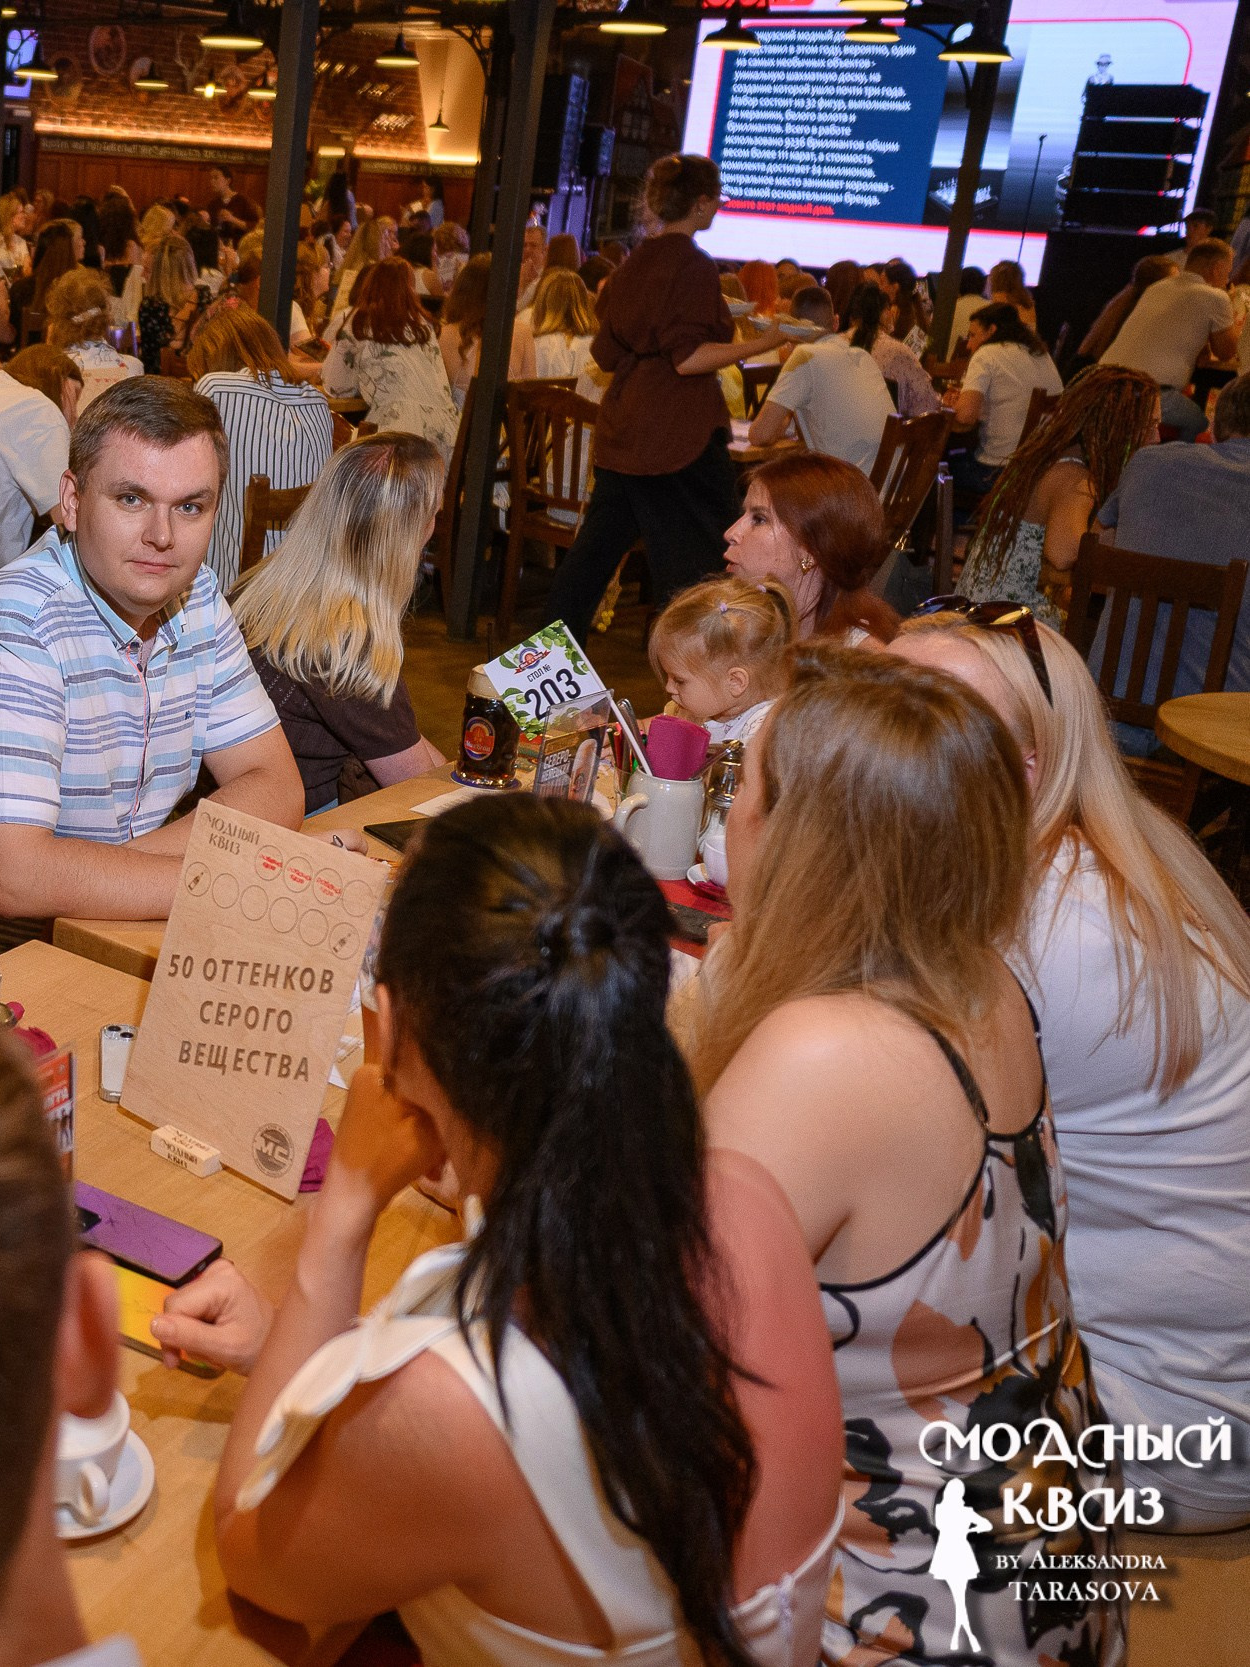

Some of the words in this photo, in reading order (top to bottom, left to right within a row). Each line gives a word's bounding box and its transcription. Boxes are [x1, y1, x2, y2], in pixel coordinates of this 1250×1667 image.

[797, 29, 833, 41] модный
[796, 45, 819, 54] этом
[891, 46, 916, 57] один
[748, 58, 775, 68] самых
[786, 71, 837, 84] шахматную
[869, 73, 881, 83] на
[732, 83, 772, 94] создание
[773, 83, 810, 96] которой
[811, 84, 835, 97] ушло
[836, 85, 863, 95] почти
[730, 95, 758, 109] Набор
[759, 97, 794, 108] состоит
[785, 109, 816, 121] белого
[817, 111, 848, 122] золота
[785, 122, 810, 134] Всего
[818, 124, 851, 137] работе
[784, 136, 806, 149] 9236
[865, 139, 900, 153] общим
[722, 148, 749, 158] весом
[750, 147, 777, 159] более
[825, 152, 873, 165] стоимость
[744, 186, 770, 199] самой
[775, 176, 802, 187] место
[802, 177, 845, 189] занимает
[845, 180, 888, 193] королева
[527, 667, 544, 683] СТОЛ
[524, 668, 581, 721] 203
[201, 811, 260, 846] МОДНЫЙ
[208, 832, 241, 856] КВИЗ
[168, 954, 194, 980] 50
[203, 957, 335, 995] ОТТЕНКОВ
[199, 1000, 293, 1034] СЕРОГО
[178, 1040, 310, 1083] ВЕЩЕСТВА
